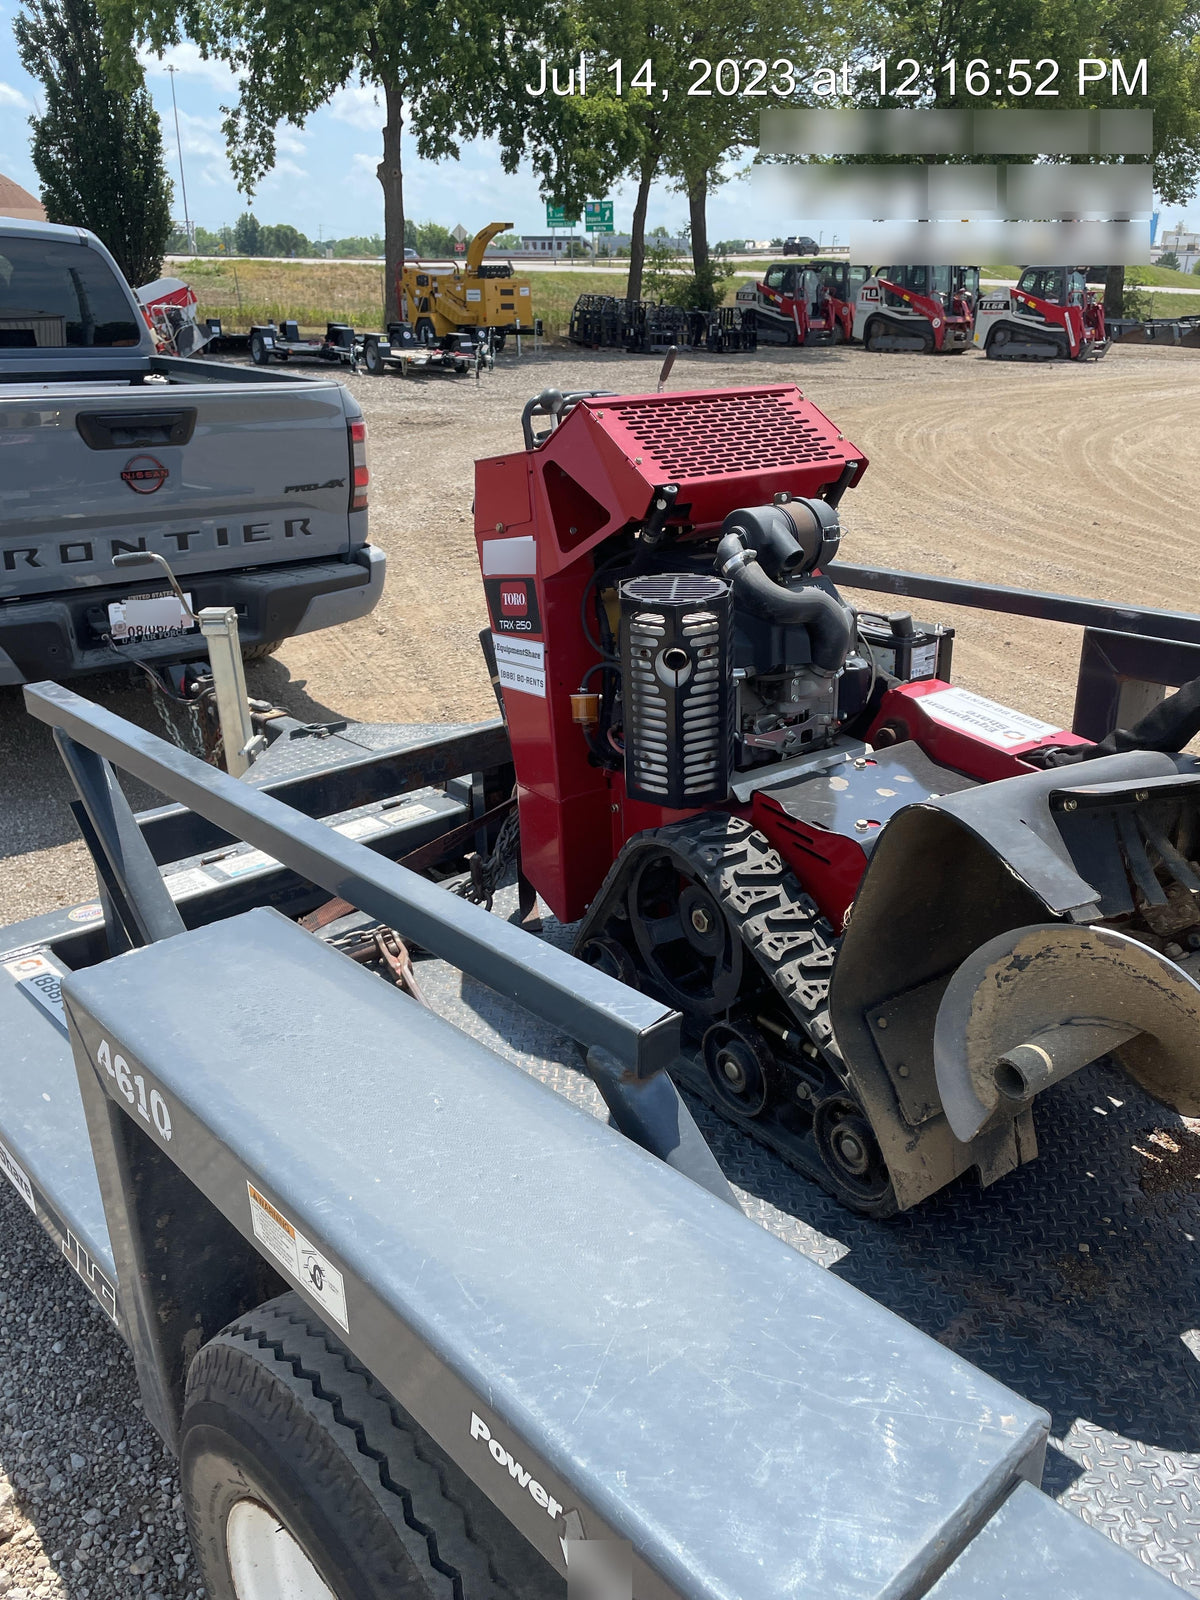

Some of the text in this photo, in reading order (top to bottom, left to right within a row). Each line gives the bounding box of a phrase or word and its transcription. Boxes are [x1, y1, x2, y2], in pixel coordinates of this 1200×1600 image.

[121, 469, 169, 481] NISSAN
[127, 590, 174, 601] UNITED STATES
[502, 592, 526, 606] TORO
[141, 632, 157, 641] AIR
[158, 628, 188, 639] FORCE
[496, 642, 541, 660] EquipmentShare
[921, 699, 1000, 734] Equipment
[964, 709, 1011, 731] Share
[470, 1411, 564, 1520] Power
